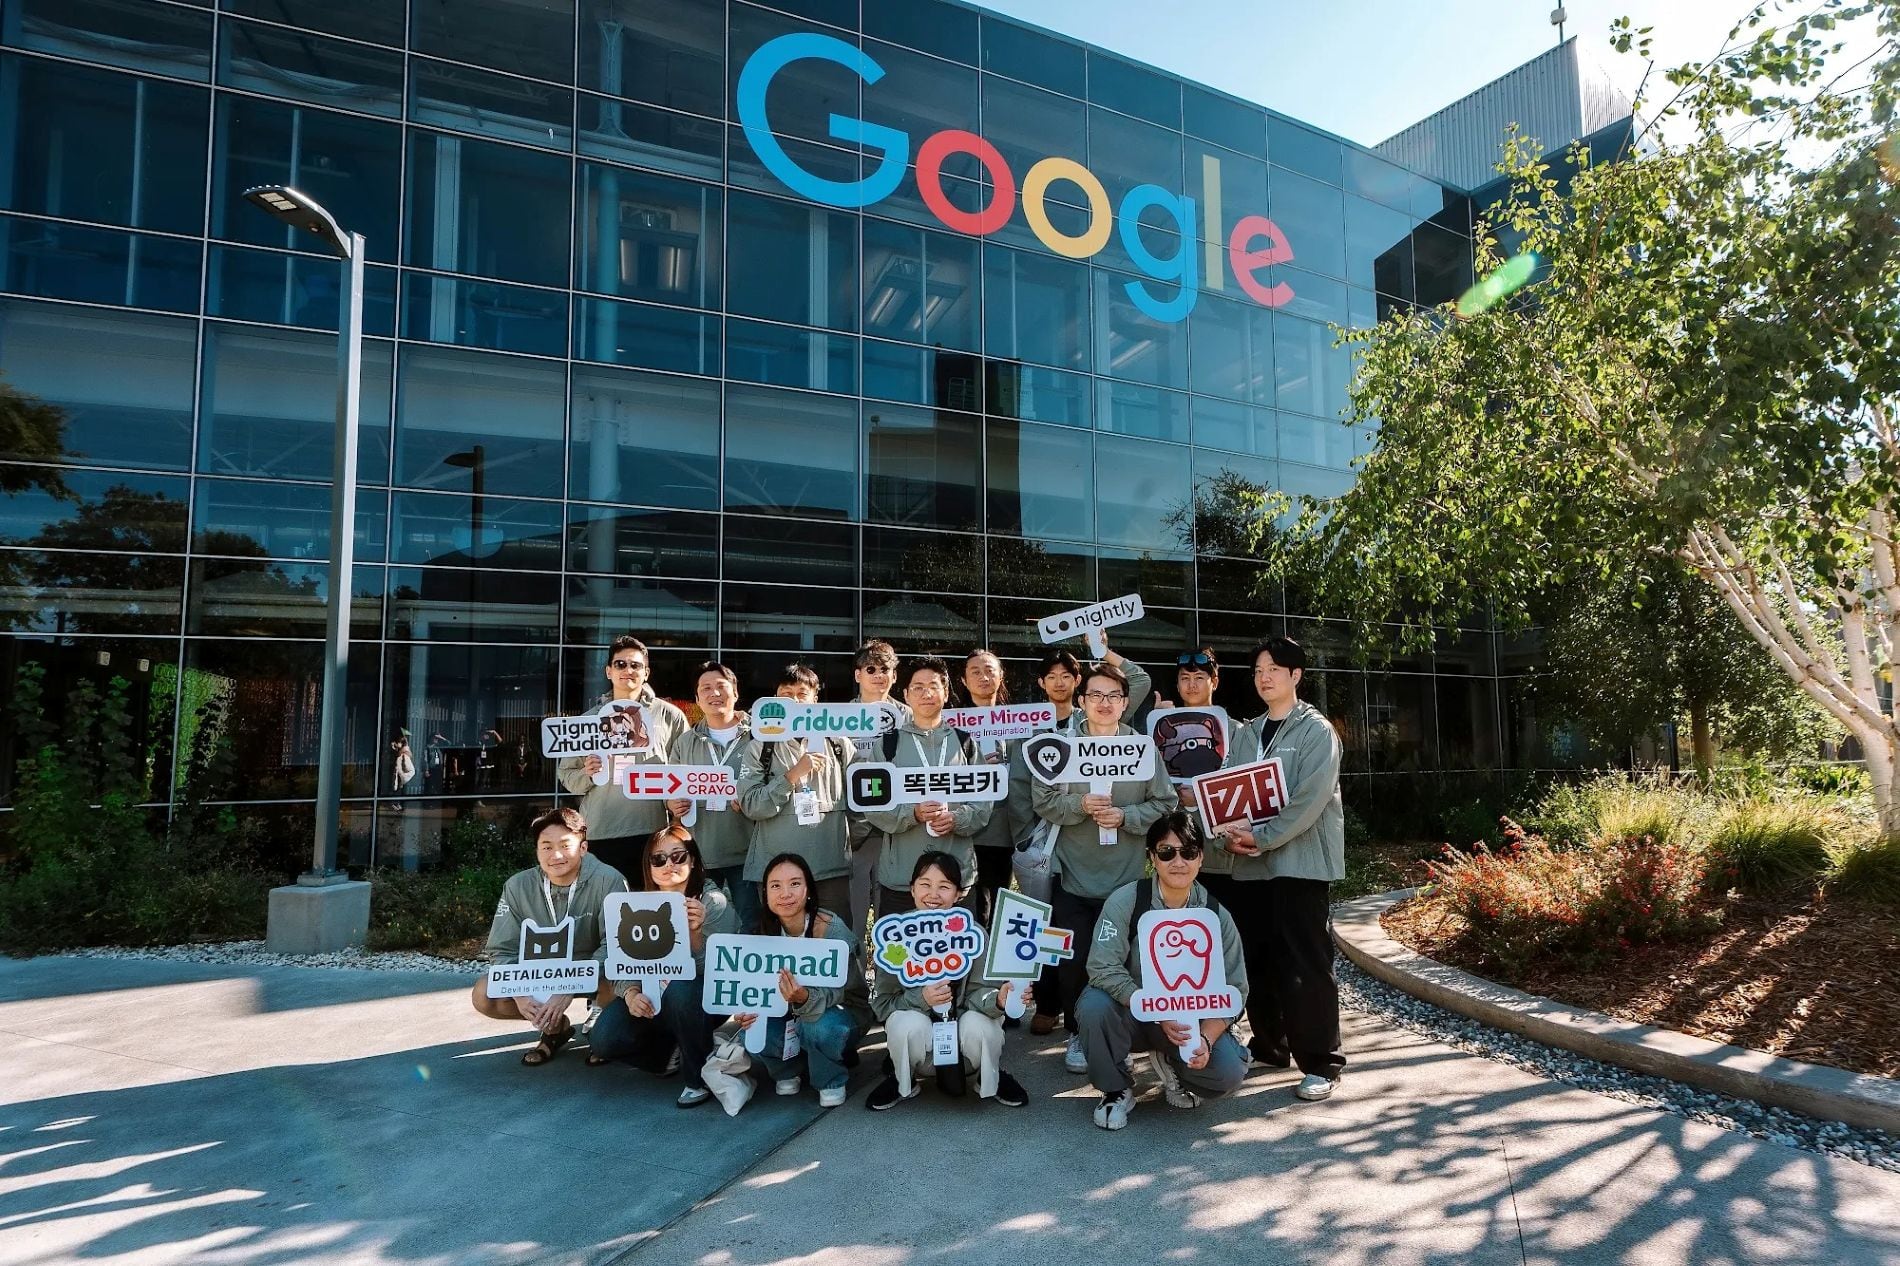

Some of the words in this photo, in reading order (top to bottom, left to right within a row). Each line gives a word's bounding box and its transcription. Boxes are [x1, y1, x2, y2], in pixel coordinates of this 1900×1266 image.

[737, 33, 1296, 323] Google
[1074, 601, 1135, 628] nightly
[792, 708, 874, 731] riduck
[946, 712, 984, 728] elier
[990, 709, 1052, 726] Mirage
[983, 727, 1030, 737] Imagination
[1078, 742, 1146, 759] Money
[687, 772, 728, 783] CODE
[1080, 760, 1140, 777] Guard
[687, 784, 736, 795] CRAYO
[904, 771, 1000, 796] 똑똑보카
[883, 919, 943, 943] Gem
[914, 935, 974, 957] Gem
[616, 962, 683, 975] Pomellow
[713, 945, 839, 978] Nomad
[492, 966, 595, 982] DETAILGAMES
[501, 985, 521, 994] Devil
[542, 984, 555, 992] the
[558, 983, 584, 992] details
[712, 979, 776, 1008] Her
[1141, 994, 1232, 1013] HOMEDEN
